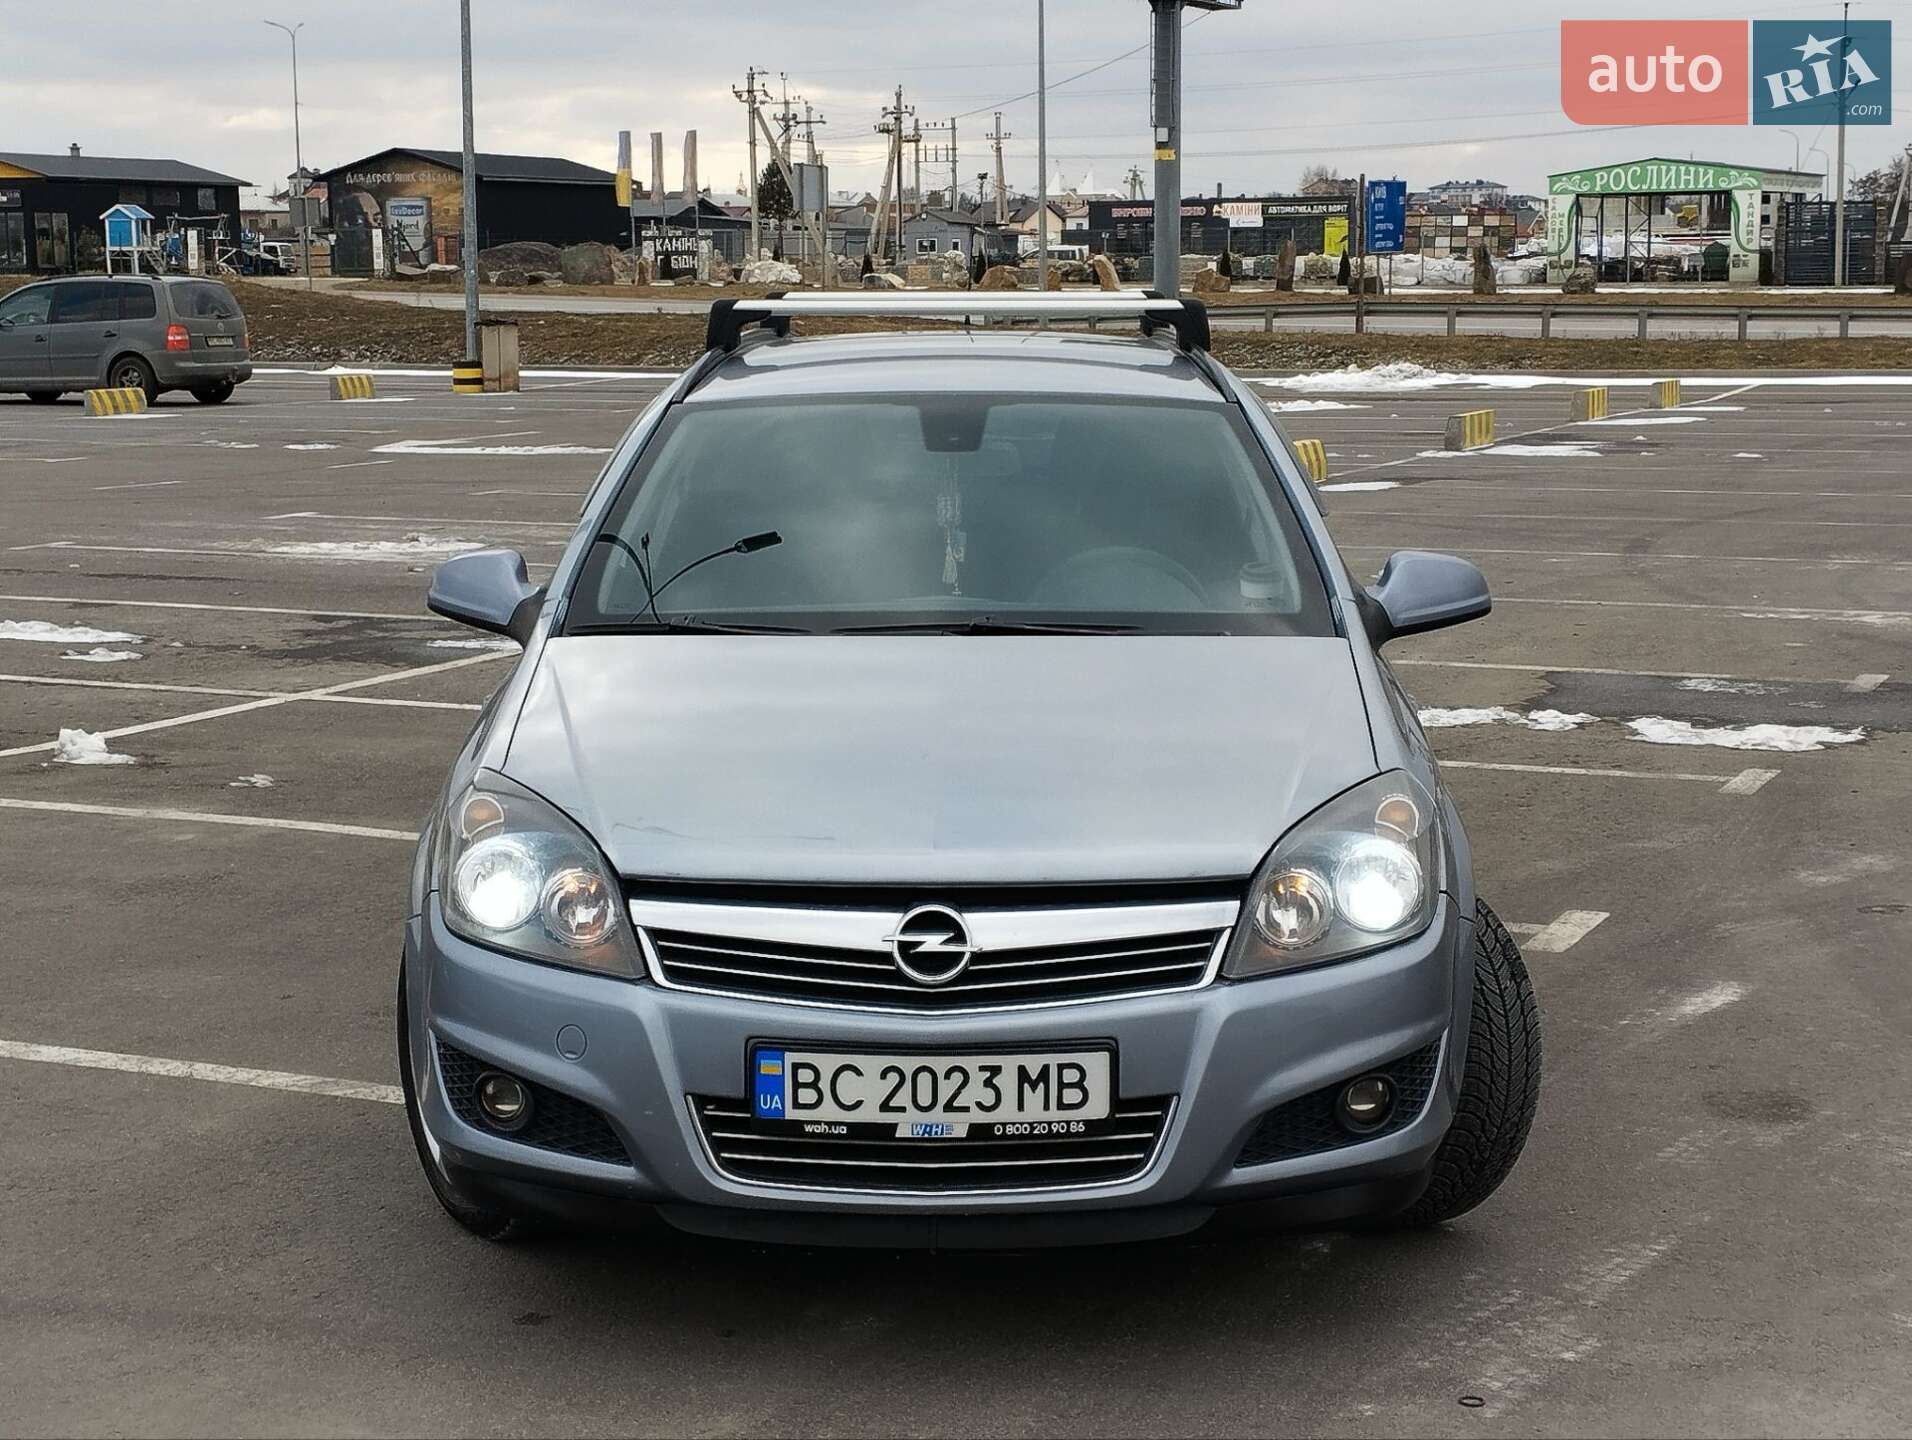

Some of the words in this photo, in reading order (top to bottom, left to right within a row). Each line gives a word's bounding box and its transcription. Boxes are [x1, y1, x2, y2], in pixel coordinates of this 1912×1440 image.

[1595, 165, 1714, 191] РОСЛИНИ
[1222, 203, 1261, 216] КАМІНИ
[1745, 193, 1755, 245] ТАНДИР
[791, 1062, 865, 1112] BC
[878, 1064, 1003, 1113] 2023
[1016, 1061, 1090, 1113] MB
[760, 1093, 783, 1110] UA
[803, 1122, 848, 1134] wah.ua
[994, 1124, 1003, 1135] 0
[1005, 1123, 1030, 1135] 800
[1032, 1123, 1048, 1134] 20
[1051, 1122, 1067, 1134] 90
[1069, 1121, 1086, 1133] 86
